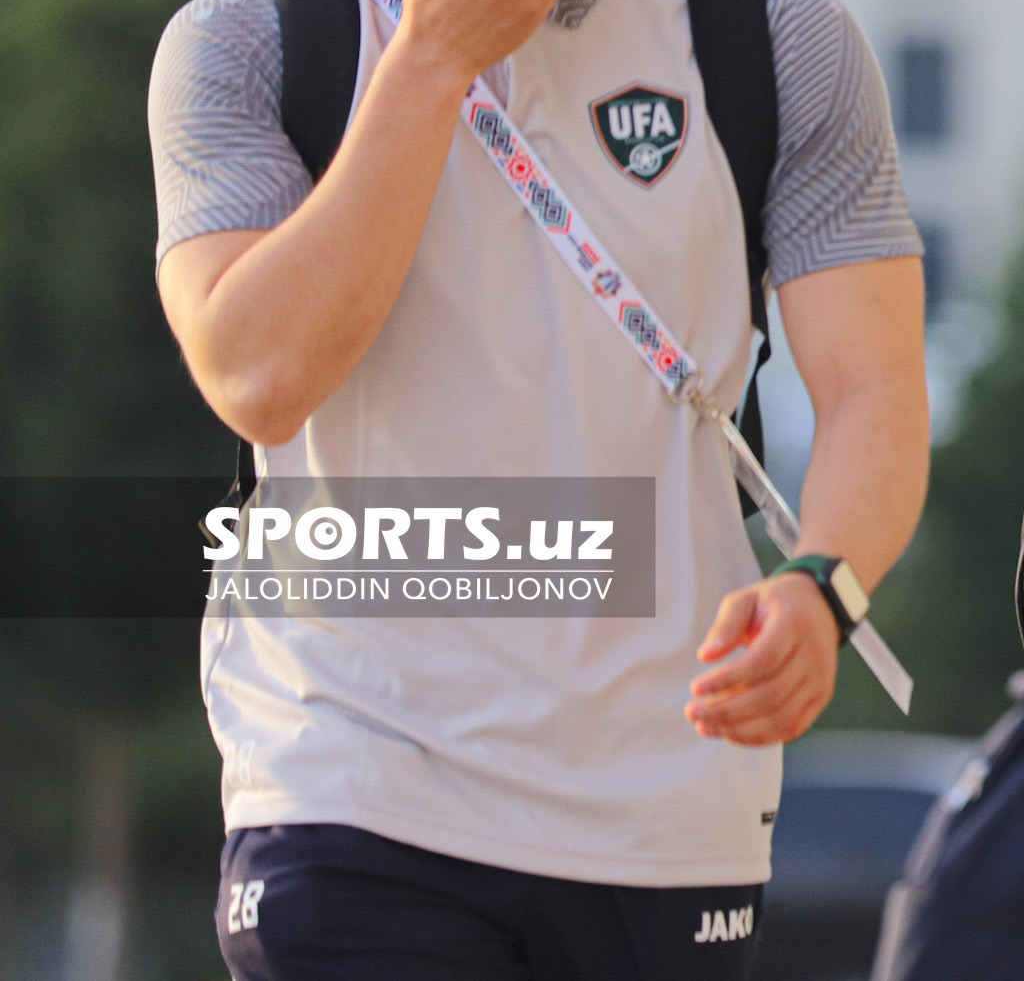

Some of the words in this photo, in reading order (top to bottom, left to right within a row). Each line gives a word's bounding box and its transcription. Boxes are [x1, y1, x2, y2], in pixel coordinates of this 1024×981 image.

[608, 102, 676, 140] UFA
[228, 879, 265, 935] 28
[694, 903, 754, 943] JAKO
